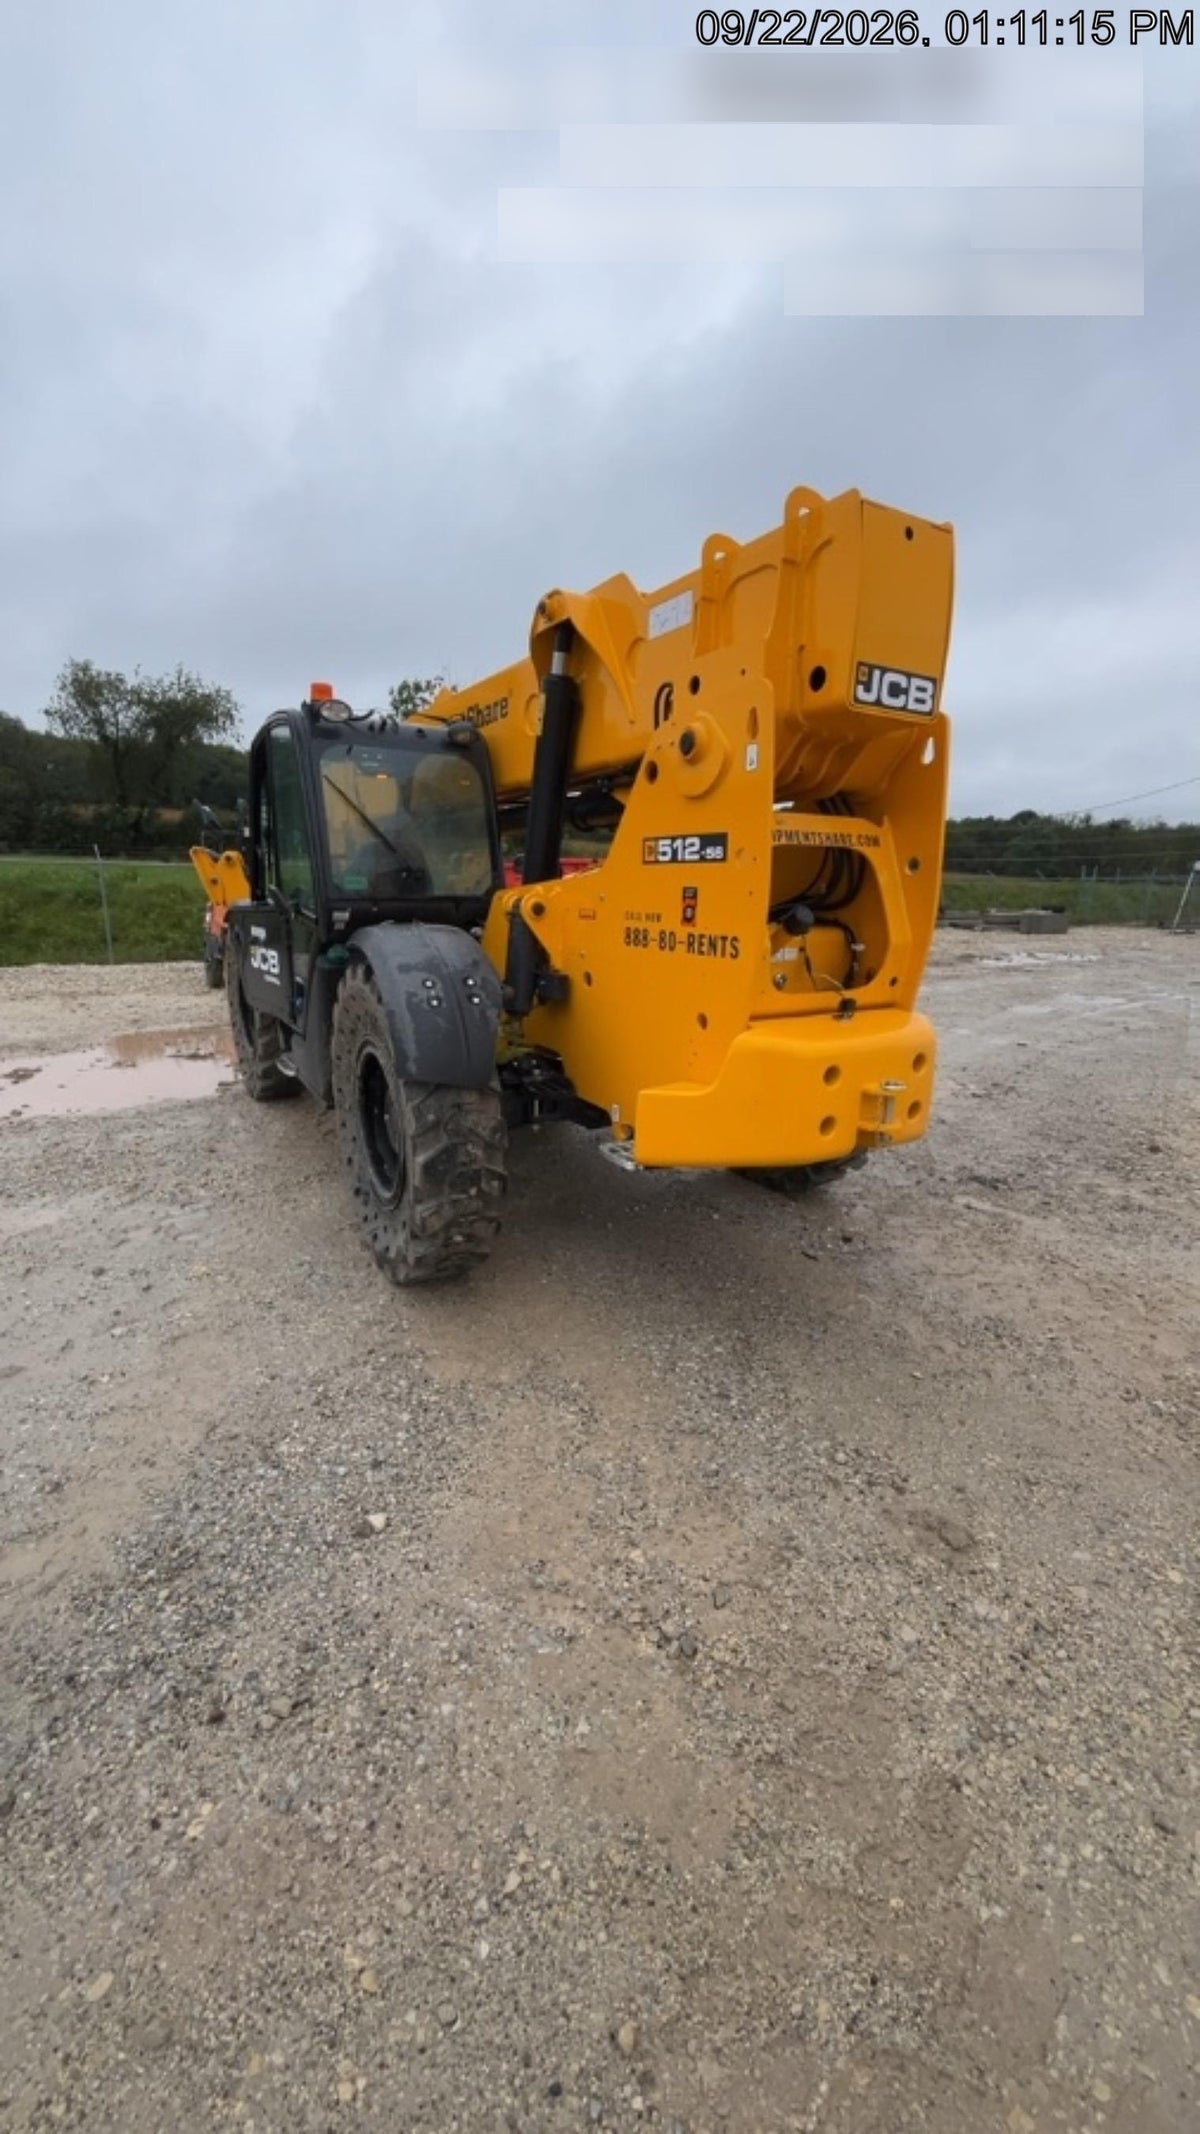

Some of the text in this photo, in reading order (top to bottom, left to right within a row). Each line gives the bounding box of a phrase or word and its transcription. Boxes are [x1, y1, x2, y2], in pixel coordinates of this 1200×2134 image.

[856, 668, 934, 713] JCB
[250, 946, 280, 974] JCB
[624, 926, 740, 960] 888-80-RENTS
